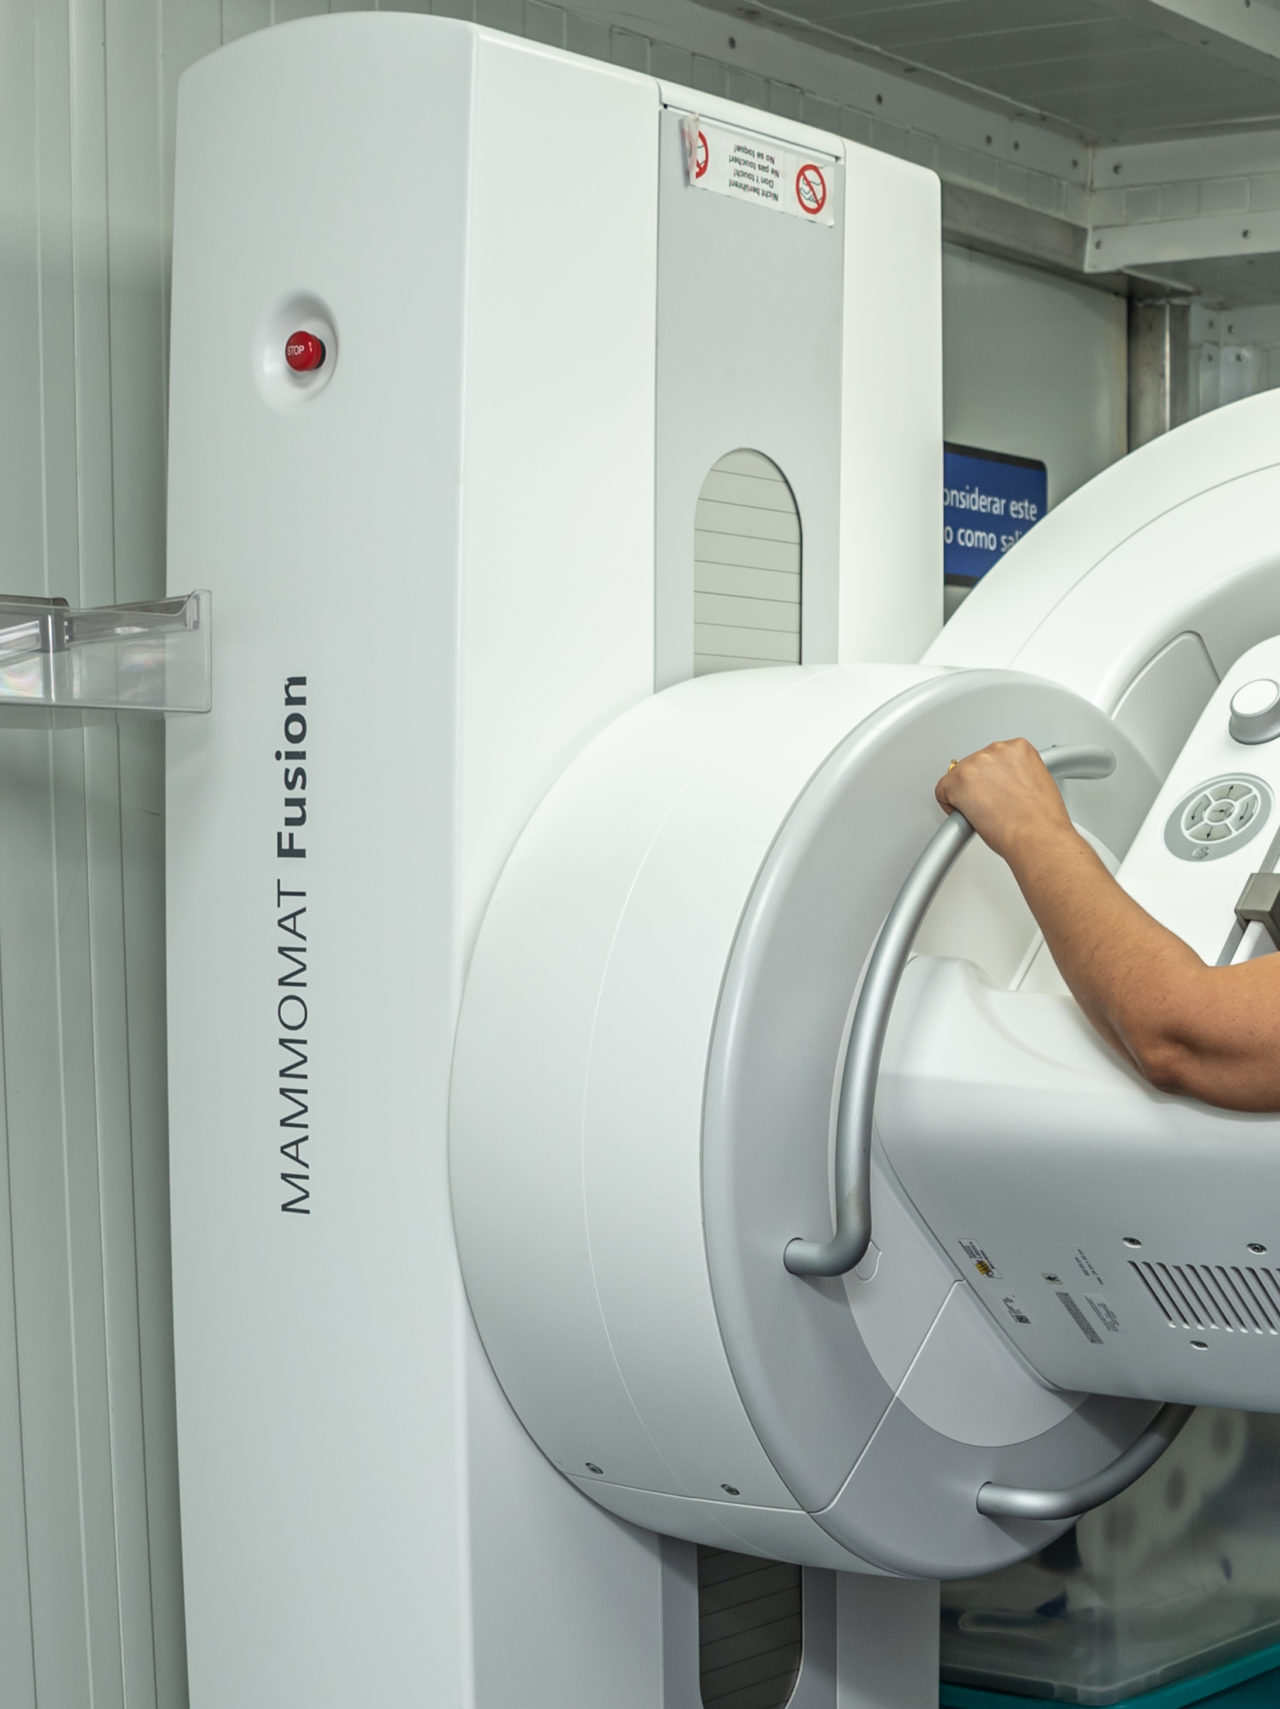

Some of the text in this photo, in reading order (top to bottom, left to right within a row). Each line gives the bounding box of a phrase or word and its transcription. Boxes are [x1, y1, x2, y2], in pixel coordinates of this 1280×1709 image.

[734, 144, 775, 164] No se toque!
[729, 155, 779, 178] Ne pas toucher!
[734, 169, 754, 182] touch!
[729, 179, 779, 201] Nicht berühren!
[286, 345, 305, 357] STOP
[1009, 499, 1038, 521] este
[957, 527, 998, 551] como
[274, 675, 310, 1215] MAMMOMAT Fusion
